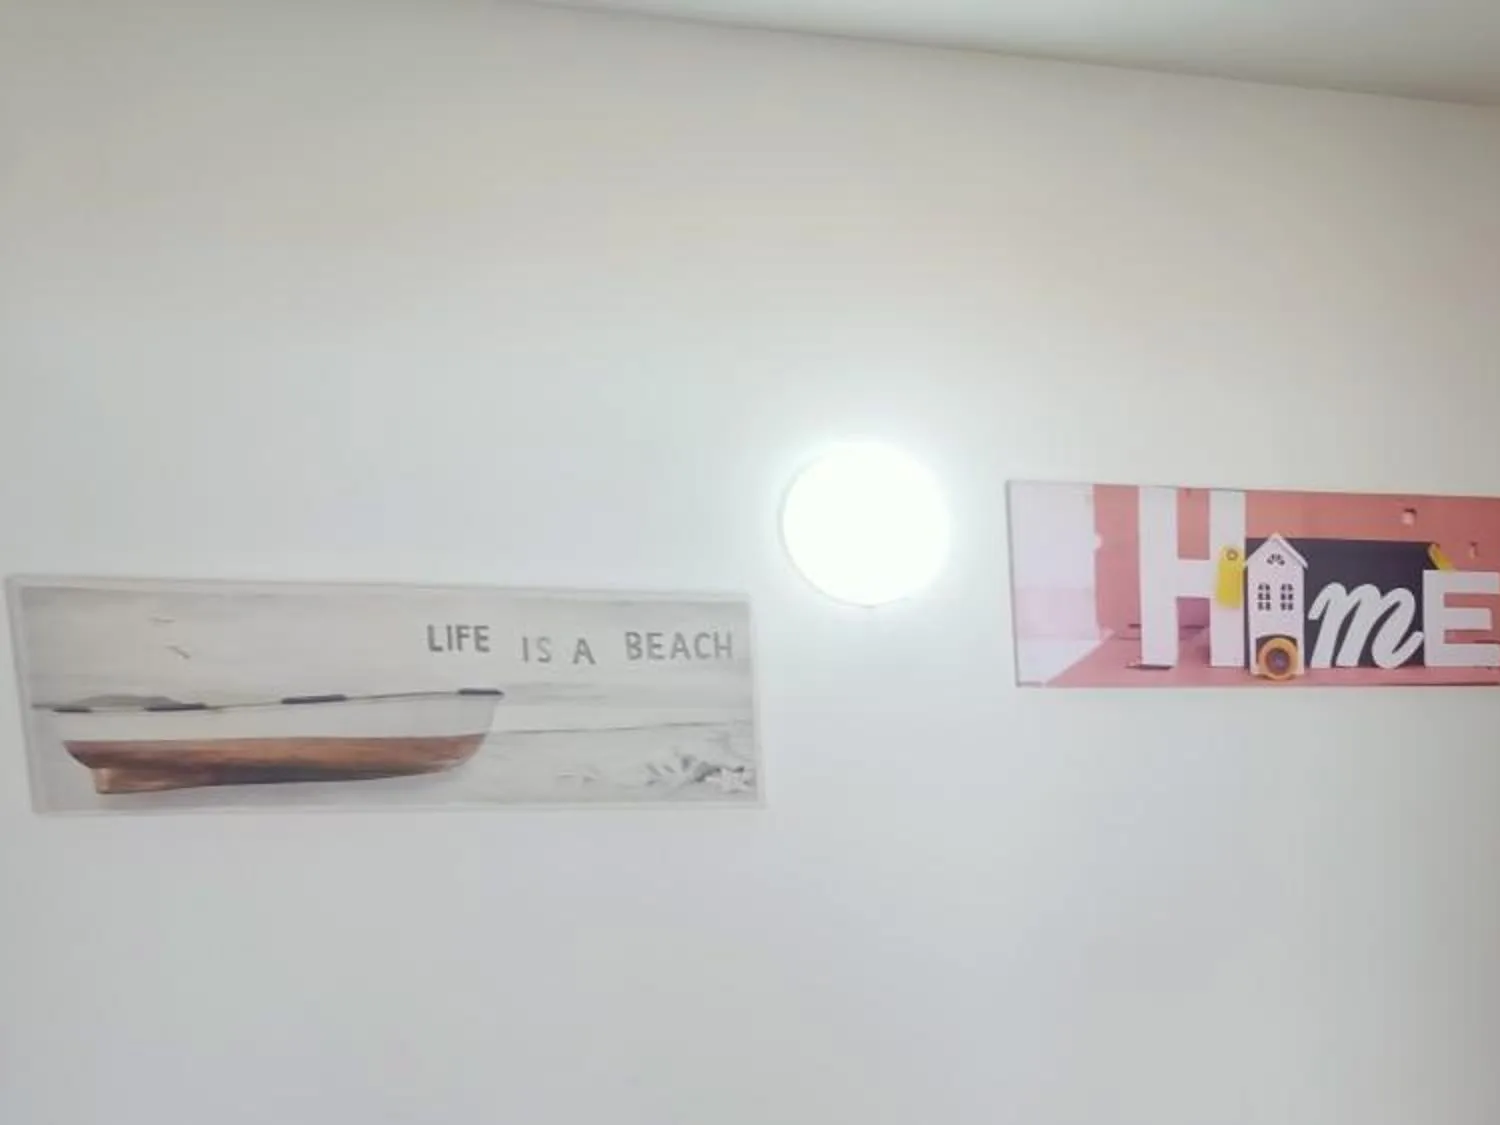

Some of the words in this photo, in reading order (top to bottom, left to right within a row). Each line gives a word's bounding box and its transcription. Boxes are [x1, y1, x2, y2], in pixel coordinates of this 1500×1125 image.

[426, 624, 491, 653] LIFE
[520, 635, 553, 664] IS
[571, 637, 597, 665] A
[623, 630, 734, 661] BEACH
